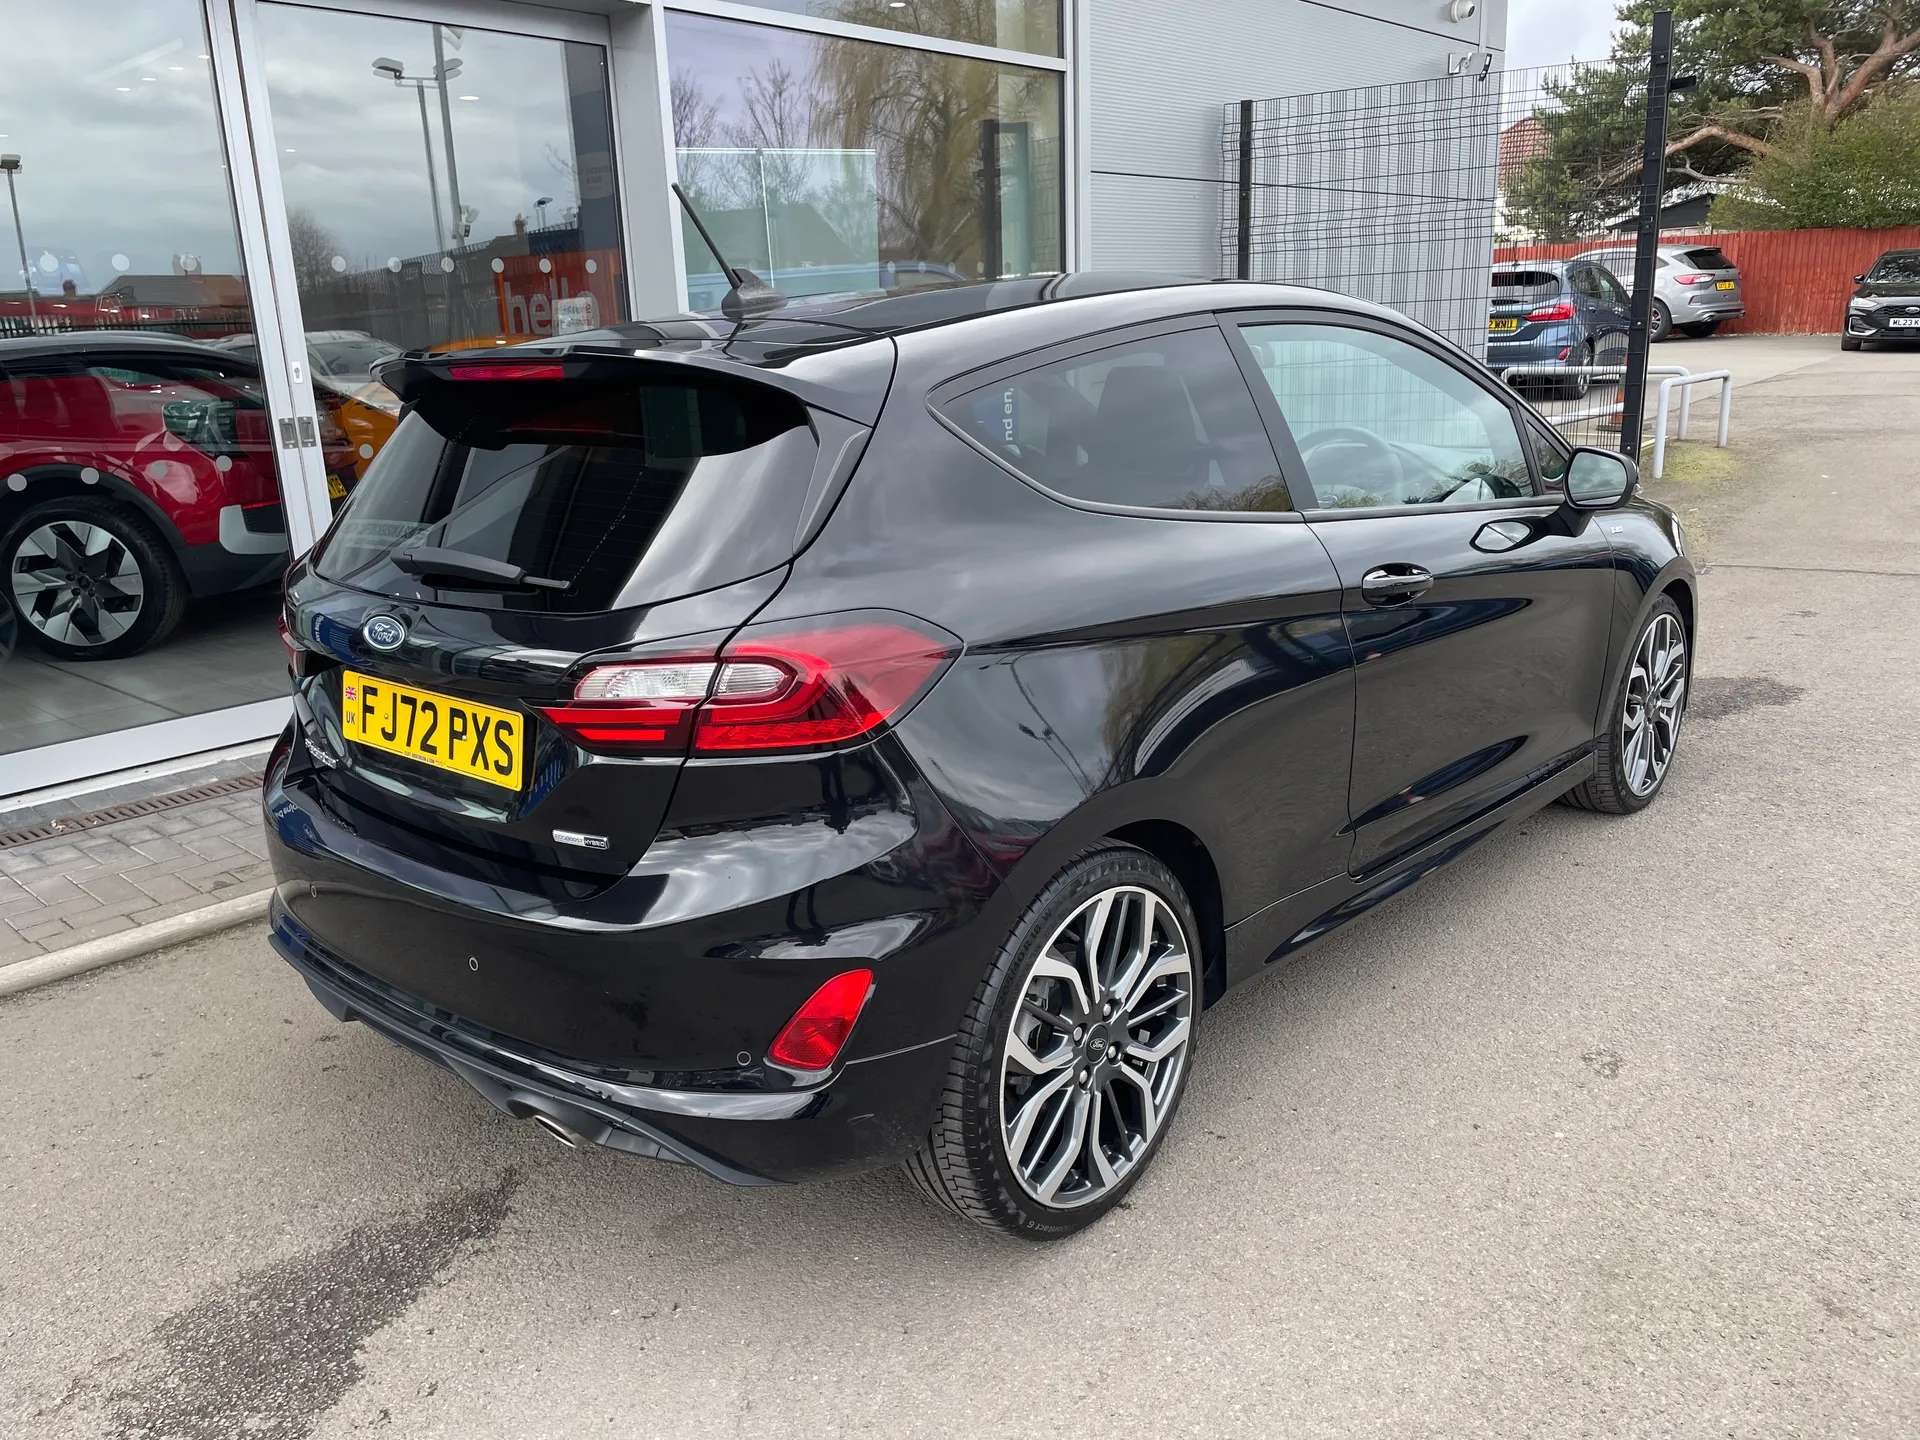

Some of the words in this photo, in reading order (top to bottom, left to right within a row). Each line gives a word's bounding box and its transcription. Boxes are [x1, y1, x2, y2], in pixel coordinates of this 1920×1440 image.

[346, 711, 356, 725] UK
[362, 685, 438, 755] FJ72
[449, 706, 514, 776] PXS
